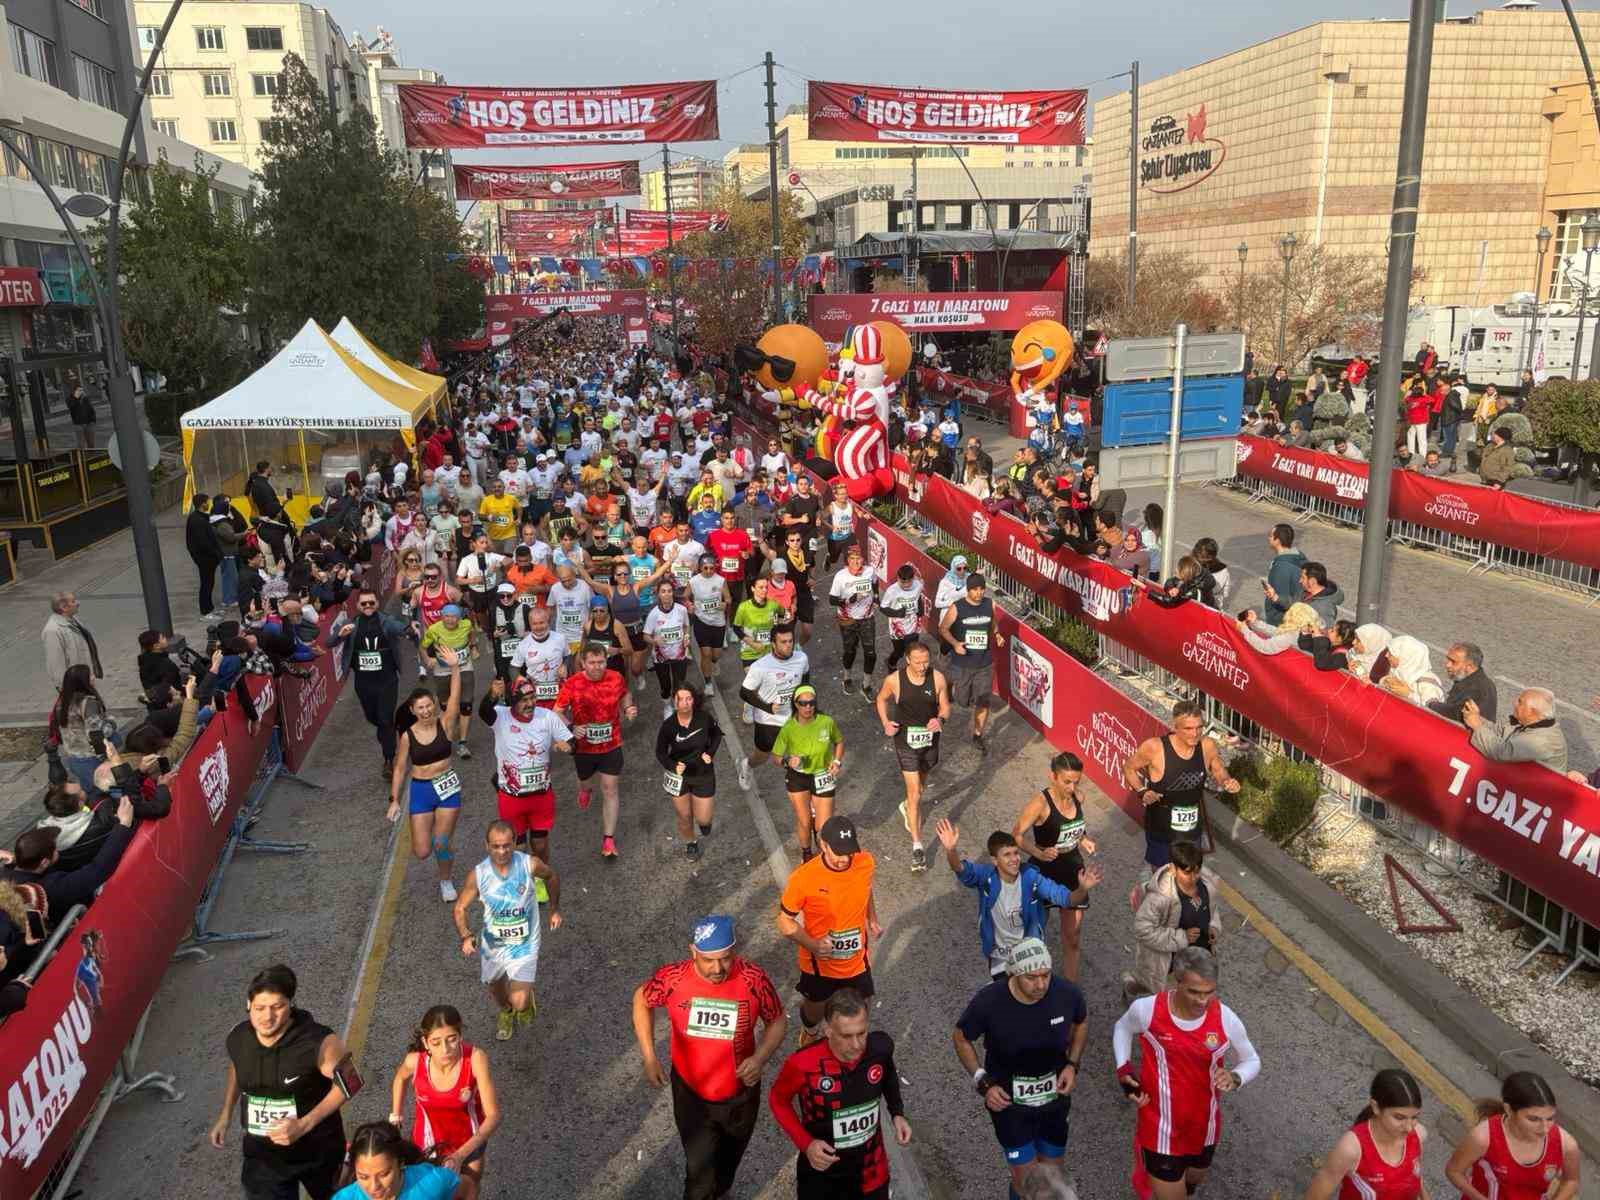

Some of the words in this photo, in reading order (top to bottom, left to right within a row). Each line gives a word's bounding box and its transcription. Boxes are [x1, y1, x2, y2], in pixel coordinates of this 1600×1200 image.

[469, 100, 527, 131] HOŞ
[867, 99, 917, 129] HOŞ
[913, 299, 940, 313] YARI
[942, 298, 1010, 313] MARATONU
[914, 315, 934, 324] HALK
[1494, 331, 1513, 342] TRT
[1036, 552, 1058, 582] YARI
[1058, 566, 1121, 614] MARATONU
[497, 925, 525, 939] 1851
[696, 1010, 730, 1028] 1195
[1016, 1080, 1054, 1097] 1450
[35, 1083, 69, 1140] 2025
[839, 1111, 875, 1136] 1401
